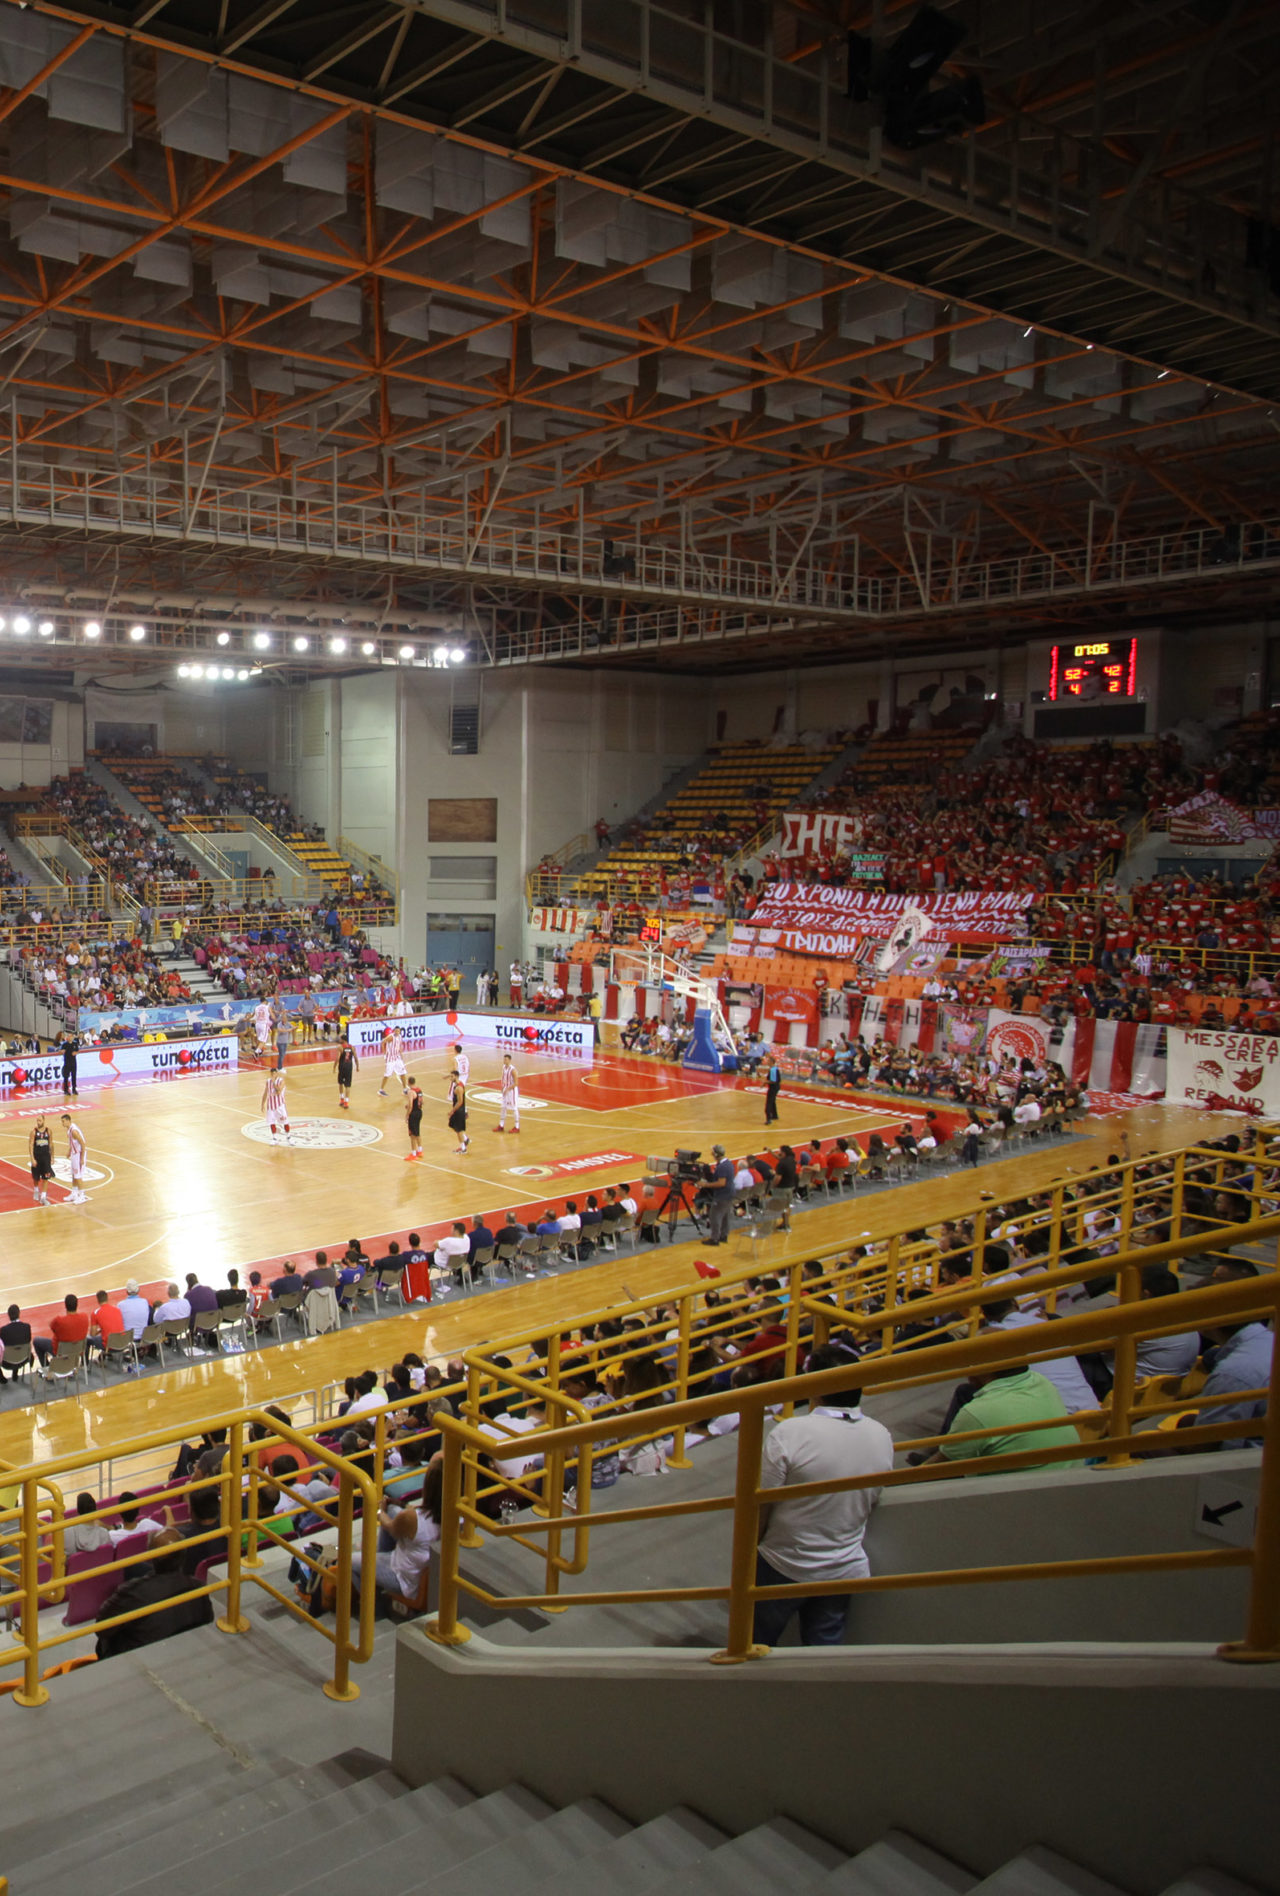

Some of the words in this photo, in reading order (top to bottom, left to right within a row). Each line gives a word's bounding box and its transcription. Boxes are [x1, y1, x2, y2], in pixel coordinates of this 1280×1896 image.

[1074, 643, 1110, 657] 07:05
[1064, 668, 1083, 681] 52
[1103, 664, 1122, 677] 42
[1070, 683, 1081, 695] 4
[1108, 681, 1120, 693] 2
[640, 926, 659, 941] 24
[783, 930, 857, 953] ΤΡΙΠΟΛΗ
[1184, 1032, 1278, 1054] MESSARA
[18, 1103, 92, 1117] AMSTEL
[558, 1152, 633, 1171] AMSTEL
